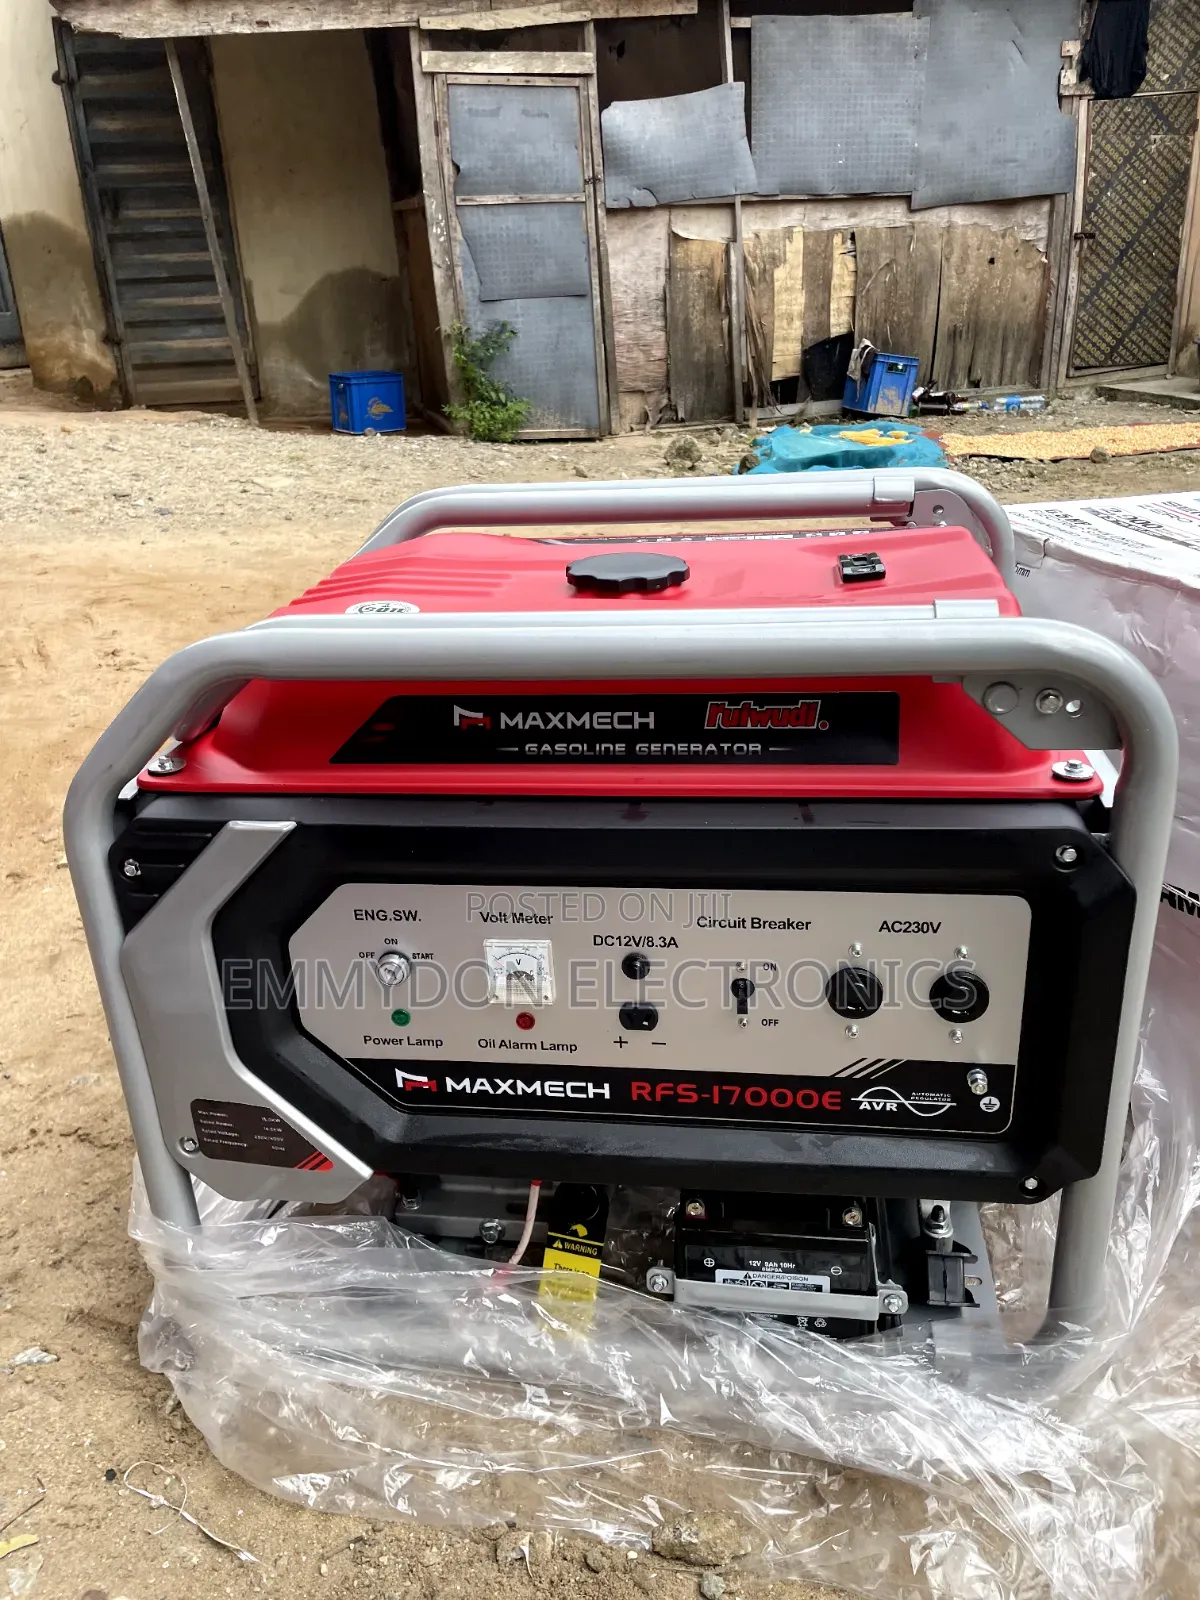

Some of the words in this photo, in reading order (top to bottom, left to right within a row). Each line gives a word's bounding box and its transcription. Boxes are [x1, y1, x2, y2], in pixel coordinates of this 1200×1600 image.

[500, 711, 655, 730] MAXMECH
[525, 743, 626, 756] GASOLINE
[635, 743, 762, 756] GENERATOR
[353, 909, 422, 922] ENG.SW.
[479, 911, 508, 924] Volt
[512, 912, 554, 925] Meter
[696, 915, 747, 930] Circuit
[750, 917, 812, 931] Breaker
[878, 920, 942, 934] AC230V
[384, 938, 398, 946] ON
[592, 934, 679, 949] DC12V/8.3A
[412, 952, 434, 960] START
[515, 958, 522, 966] V
[763, 963, 778, 972] ON
[761, 1018, 779, 1027] OFF
[363, 1035, 404, 1046] Power
[407, 1036, 444, 1049] Lamp
[478, 1038, 497, 1049] Oil
[498, 1039, 537, 1050] Alarm
[540, 1041, 578, 1053] Lamp
[445, 1077, 611, 1099] MAXMECH
[631, 1081, 842, 1110] RFS-17000E
[859, 1102, 898, 1112] AVR
[564, 1241, 598, 1256] WARNING
[748, 1260, 762, 1268] 12V
